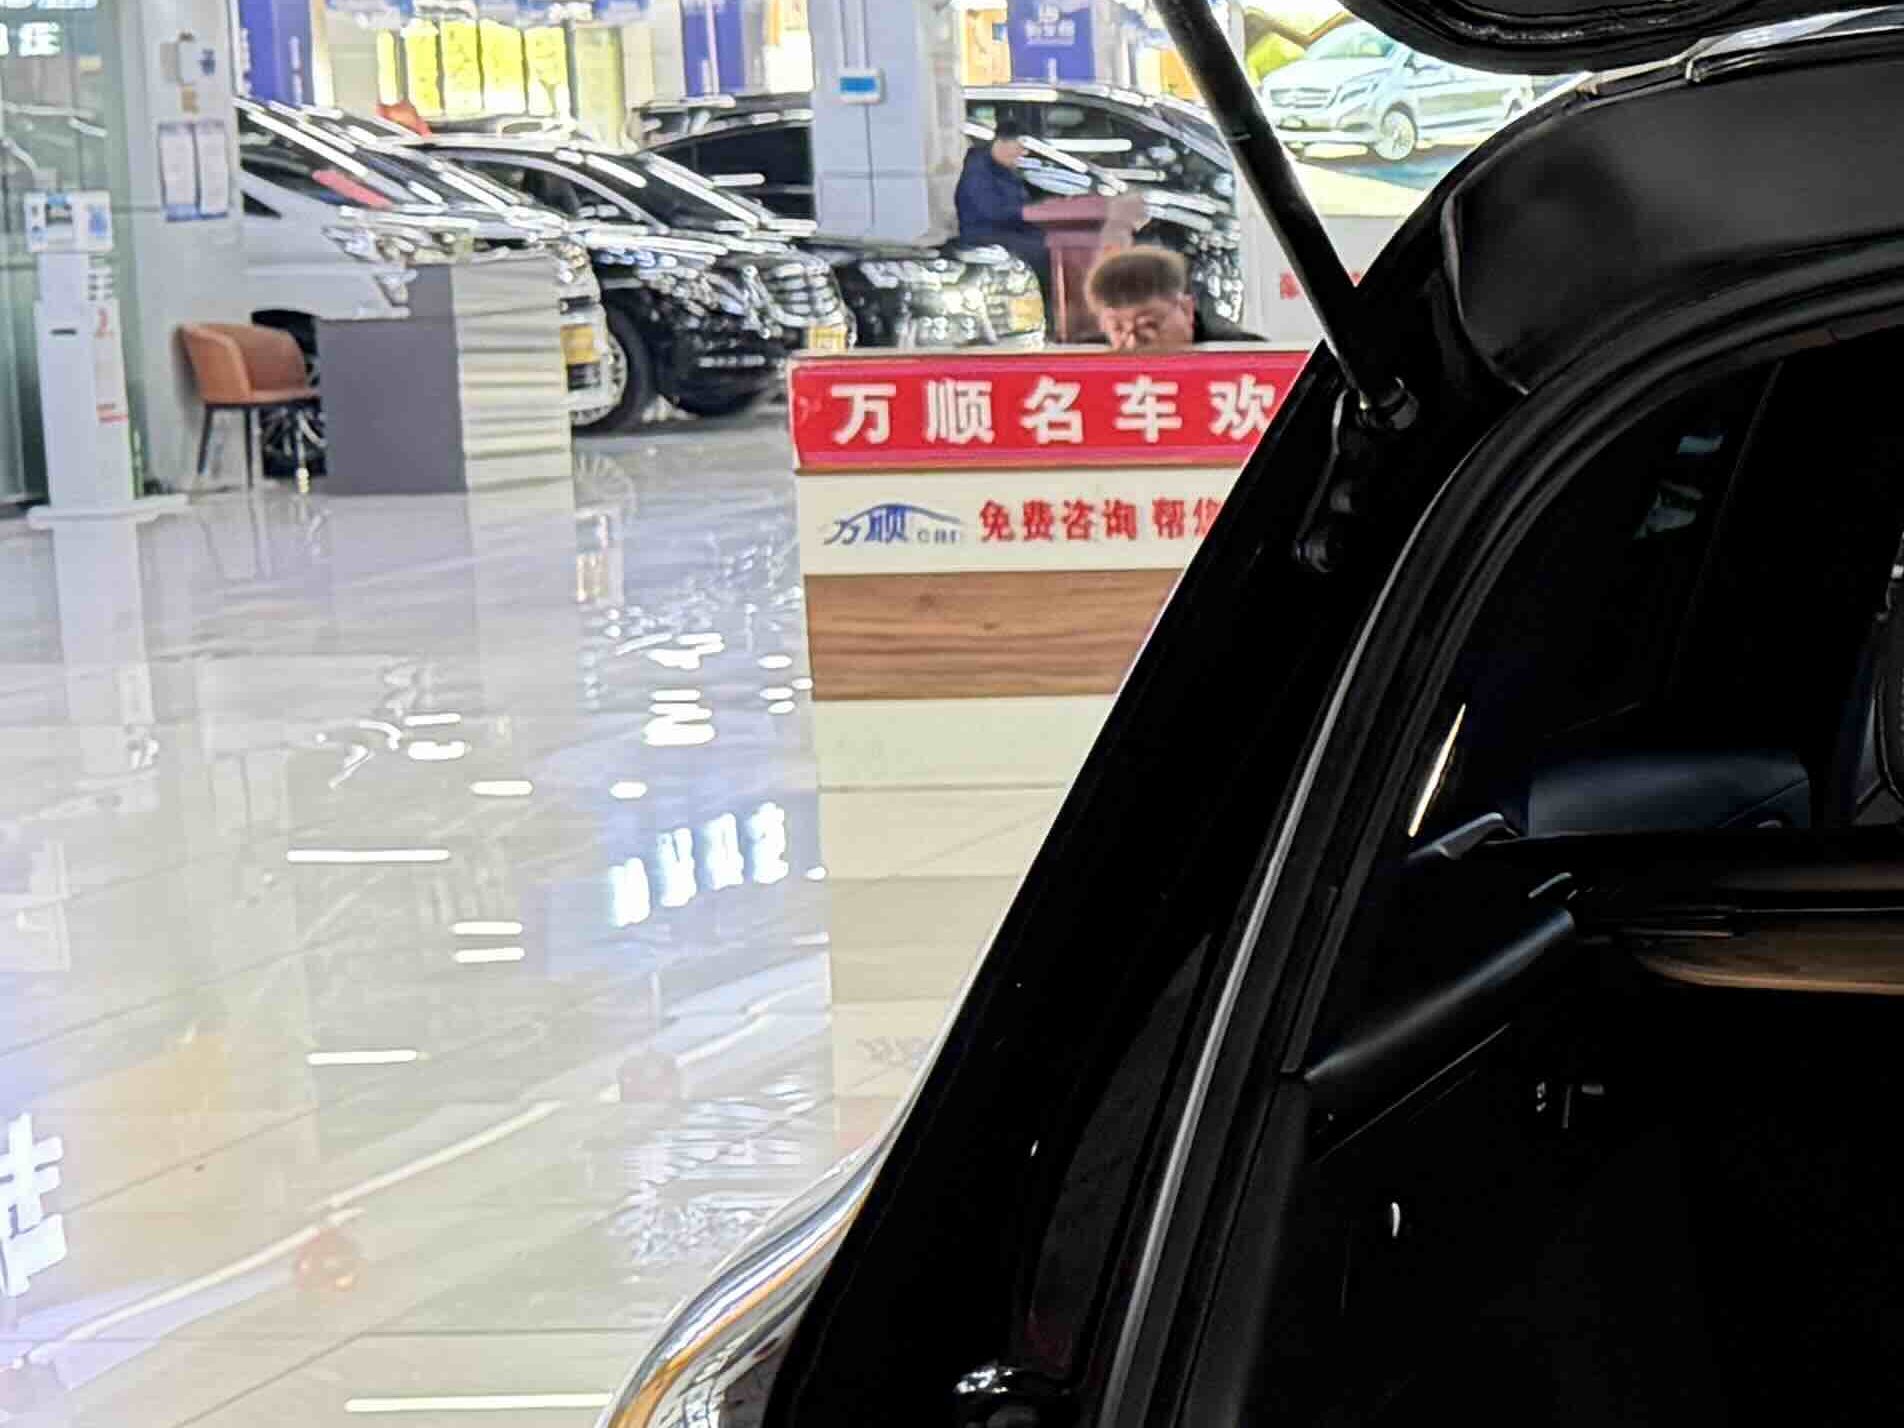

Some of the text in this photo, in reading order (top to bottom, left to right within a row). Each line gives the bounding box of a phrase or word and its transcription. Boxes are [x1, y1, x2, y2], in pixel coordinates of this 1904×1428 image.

[831, 372, 1276, 445] 万顺名车欢
[980, 499, 1137, 542] 免费咨询
